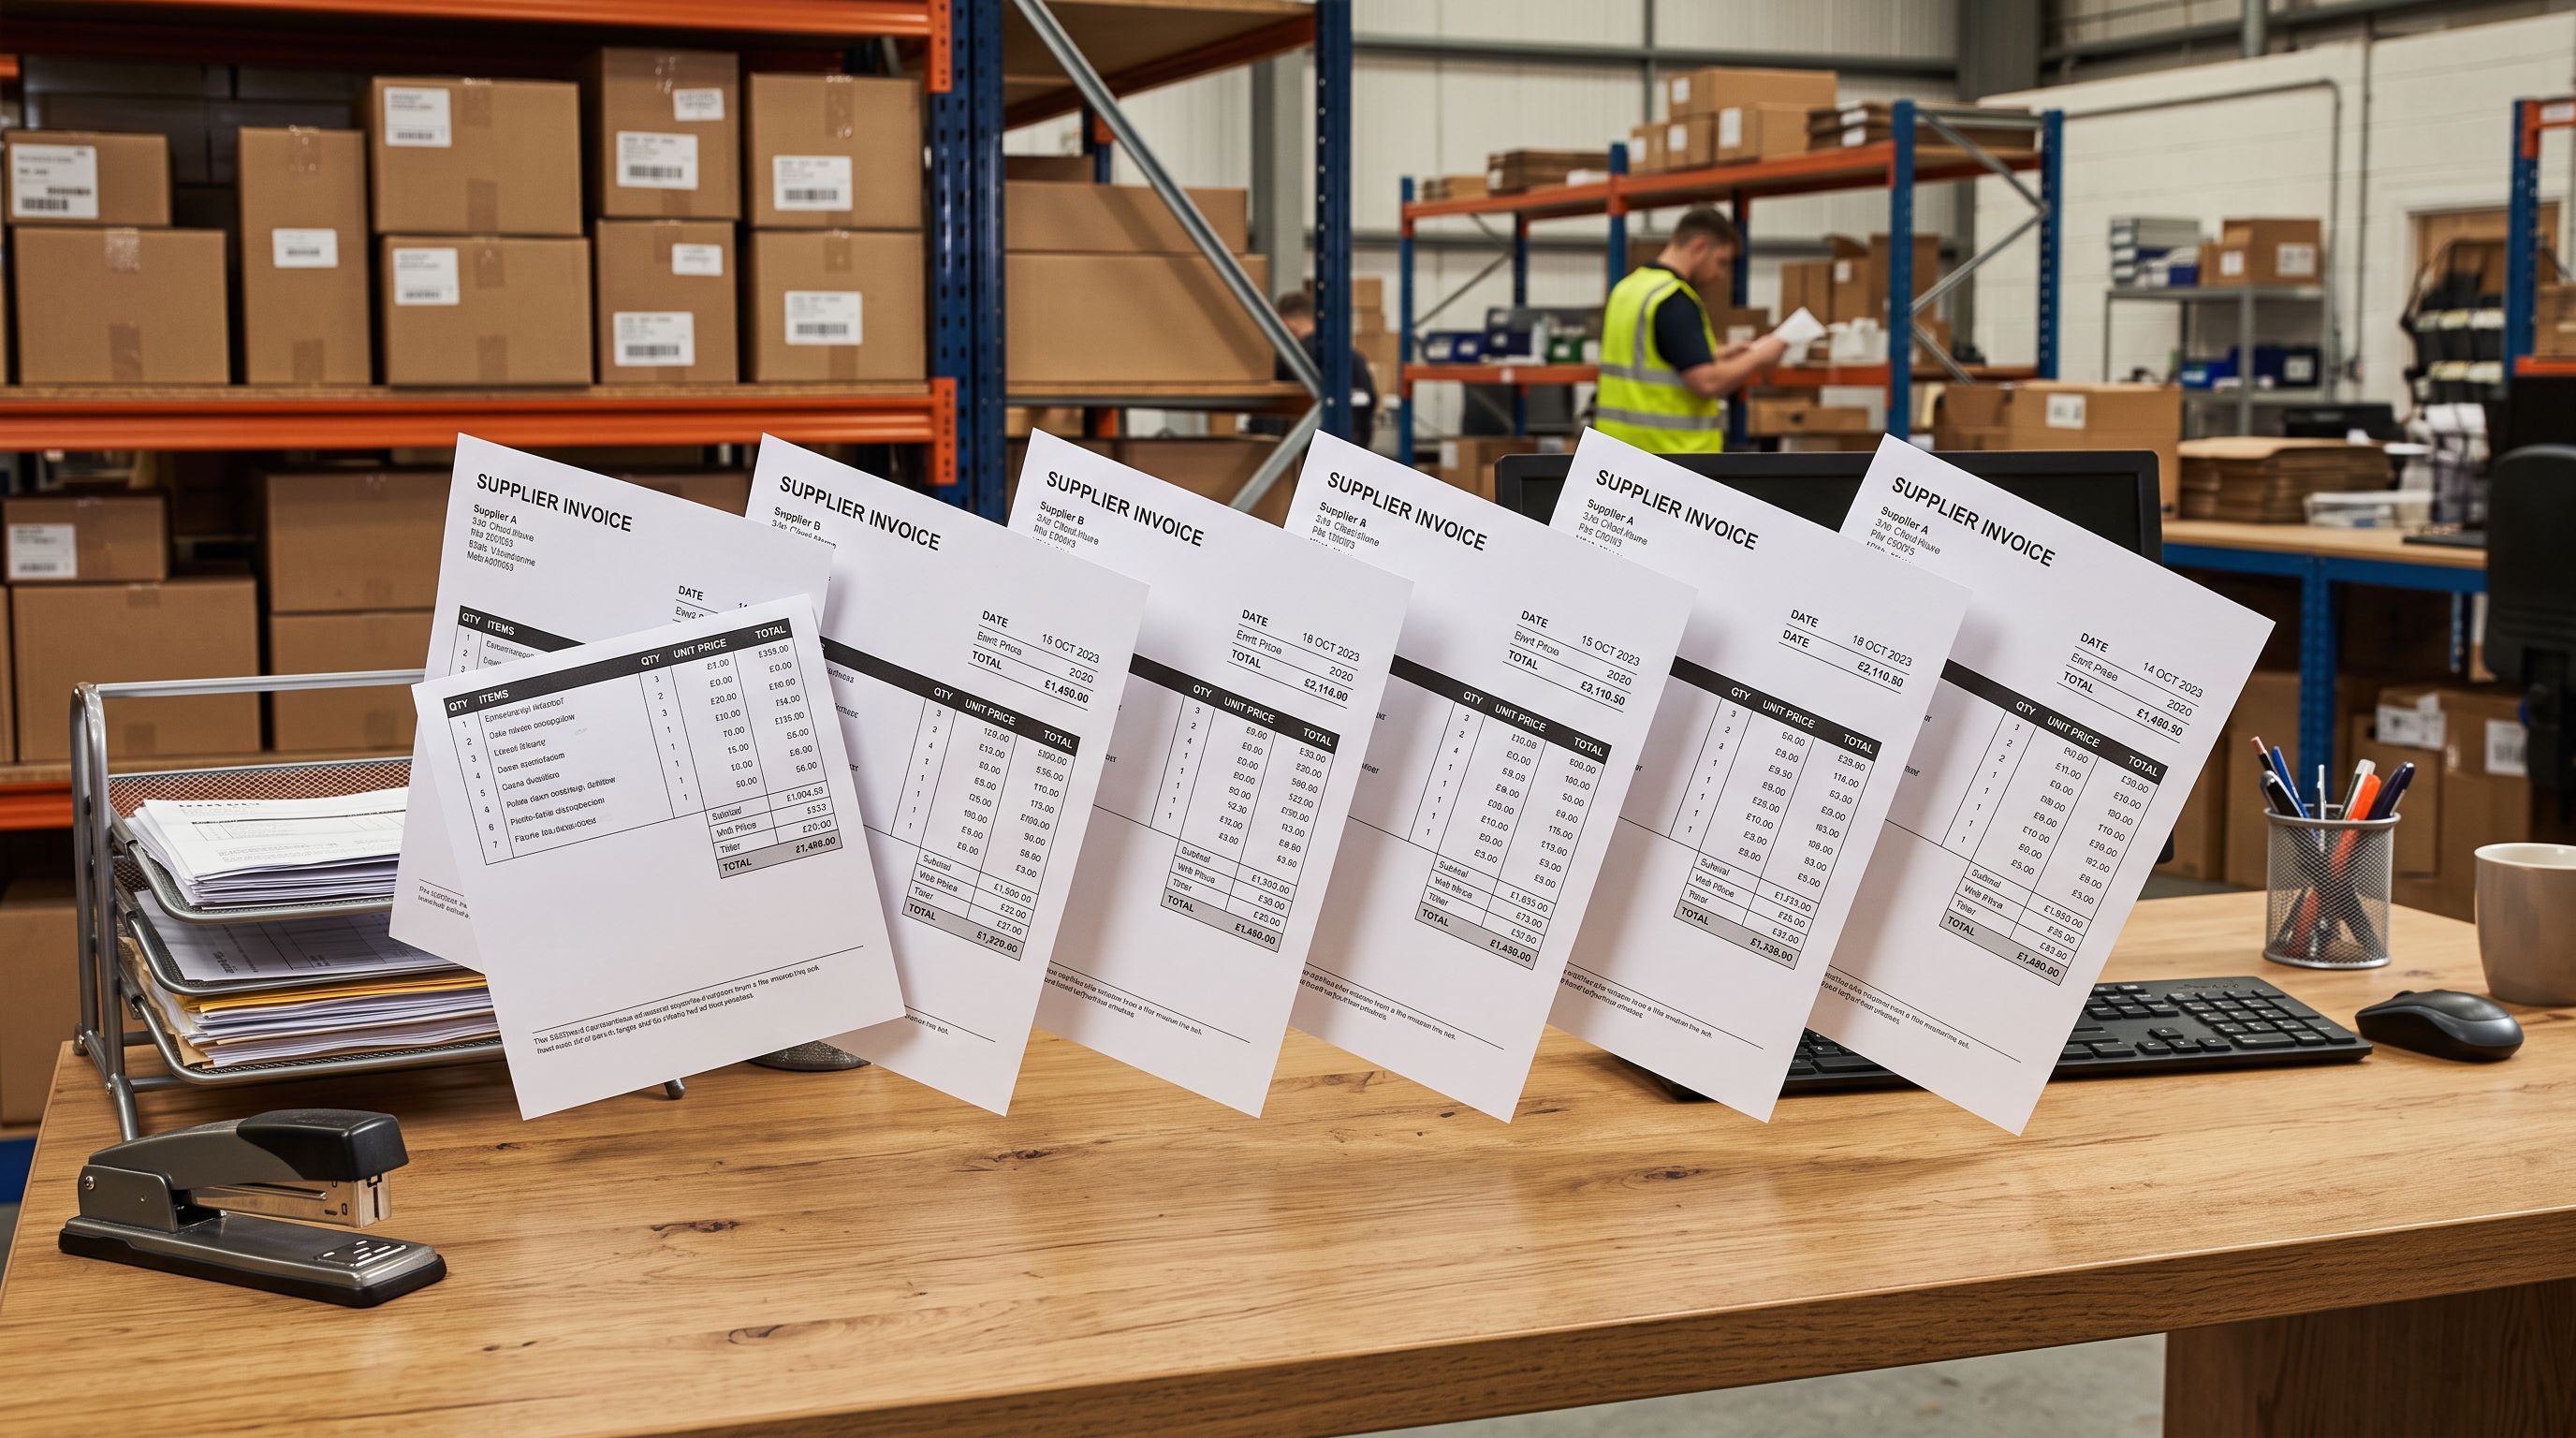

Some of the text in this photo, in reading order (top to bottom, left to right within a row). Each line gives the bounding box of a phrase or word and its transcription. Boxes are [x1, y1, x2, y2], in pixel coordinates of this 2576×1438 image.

[476, 472, 633, 533] SUPPLIER INVOICE
[779, 475, 865, 522] SUPPLIER
[868, 508, 942, 551] INVOICE
[1039, 500, 1076, 521] Supplier
[1046, 470, 1130, 518] SUPPLIER
[1133, 504, 1205, 548] INVOICE
[1326, 471, 1412, 521] SUPPLIER
[1413, 506, 1487, 551] INVOICE
[1595, 468, 1682, 519] SUPPLIER
[1683, 506, 1759, 550] INVOICE
[1891, 476, 1980, 531] SUPPLIER
[1980, 518, 2056, 567] INVOICE
[677, 584, 704, 601] DATE
[461, 611, 514, 636] QTY ITEMS
[981, 609, 1009, 628] DATE
[1054, 638, 1076, 653] OCT
[1076, 646, 1100, 664] 2023
[1240, 609, 1269, 627] DATE
[1314, 637, 1337, 653] OCT
[1336, 645, 1360, 662] 2023
[1520, 609, 1640, 667] DATE 15 OCT 2023
[1781, 628, 1810, 649] DATE
[1790, 609, 1819, 628] DATE
[1864, 639, 1888, 656] OCT
[1886, 649, 1912, 667] 2023
[448, 624, 786, 712] QTY ITEMS QTY UNIT PRICE TOTAL
[972, 649, 1003, 670] TOTAL
[1068, 667, 1094, 683] 2020
[1231, 648, 1261, 669] TOTAL
[1328, 665, 1354, 682] 2020
[1508, 649, 1538, 670] TOTAL
[1605, 668, 1632, 686] 2020
[2079, 632, 2109, 653] DATE
[2143, 661, 2155, 674] 14
[2155, 668, 2180, 685] OCT
[2063, 670, 2093, 694] TOTAL
[964, 698, 988, 713] UNIT
[987, 707, 1017, 726] PRICE
[1043, 728, 1073, 749] TOTAL
[1223, 696, 1247, 712] UNIT
[1246, 705, 1275, 724] PRICE
[1303, 726, 1332, 747] TOTAL
[1762, 698, 1786, 715] UNIT
[1784, 709, 1816, 729] PRICE
[1843, 733, 1873, 755] TOTAL
[2166, 698, 2192, 717] 2020
[1494, 703, 1517, 719] UNIT
[1516, 712, 1546, 732] PRICE
[1573, 736, 1603, 756] TOTAL
[2015, 700, 2158, 777] QTY UNIT PRICE TOTAL
[908, 902, 936, 921] TOTAL
[1166, 894, 1194, 913] TOTAL
[1422, 907, 1449, 928] TOTAL
[1681, 905, 1708, 926] TOTAL
[1947, 915, 1974, 936] TOTAL
